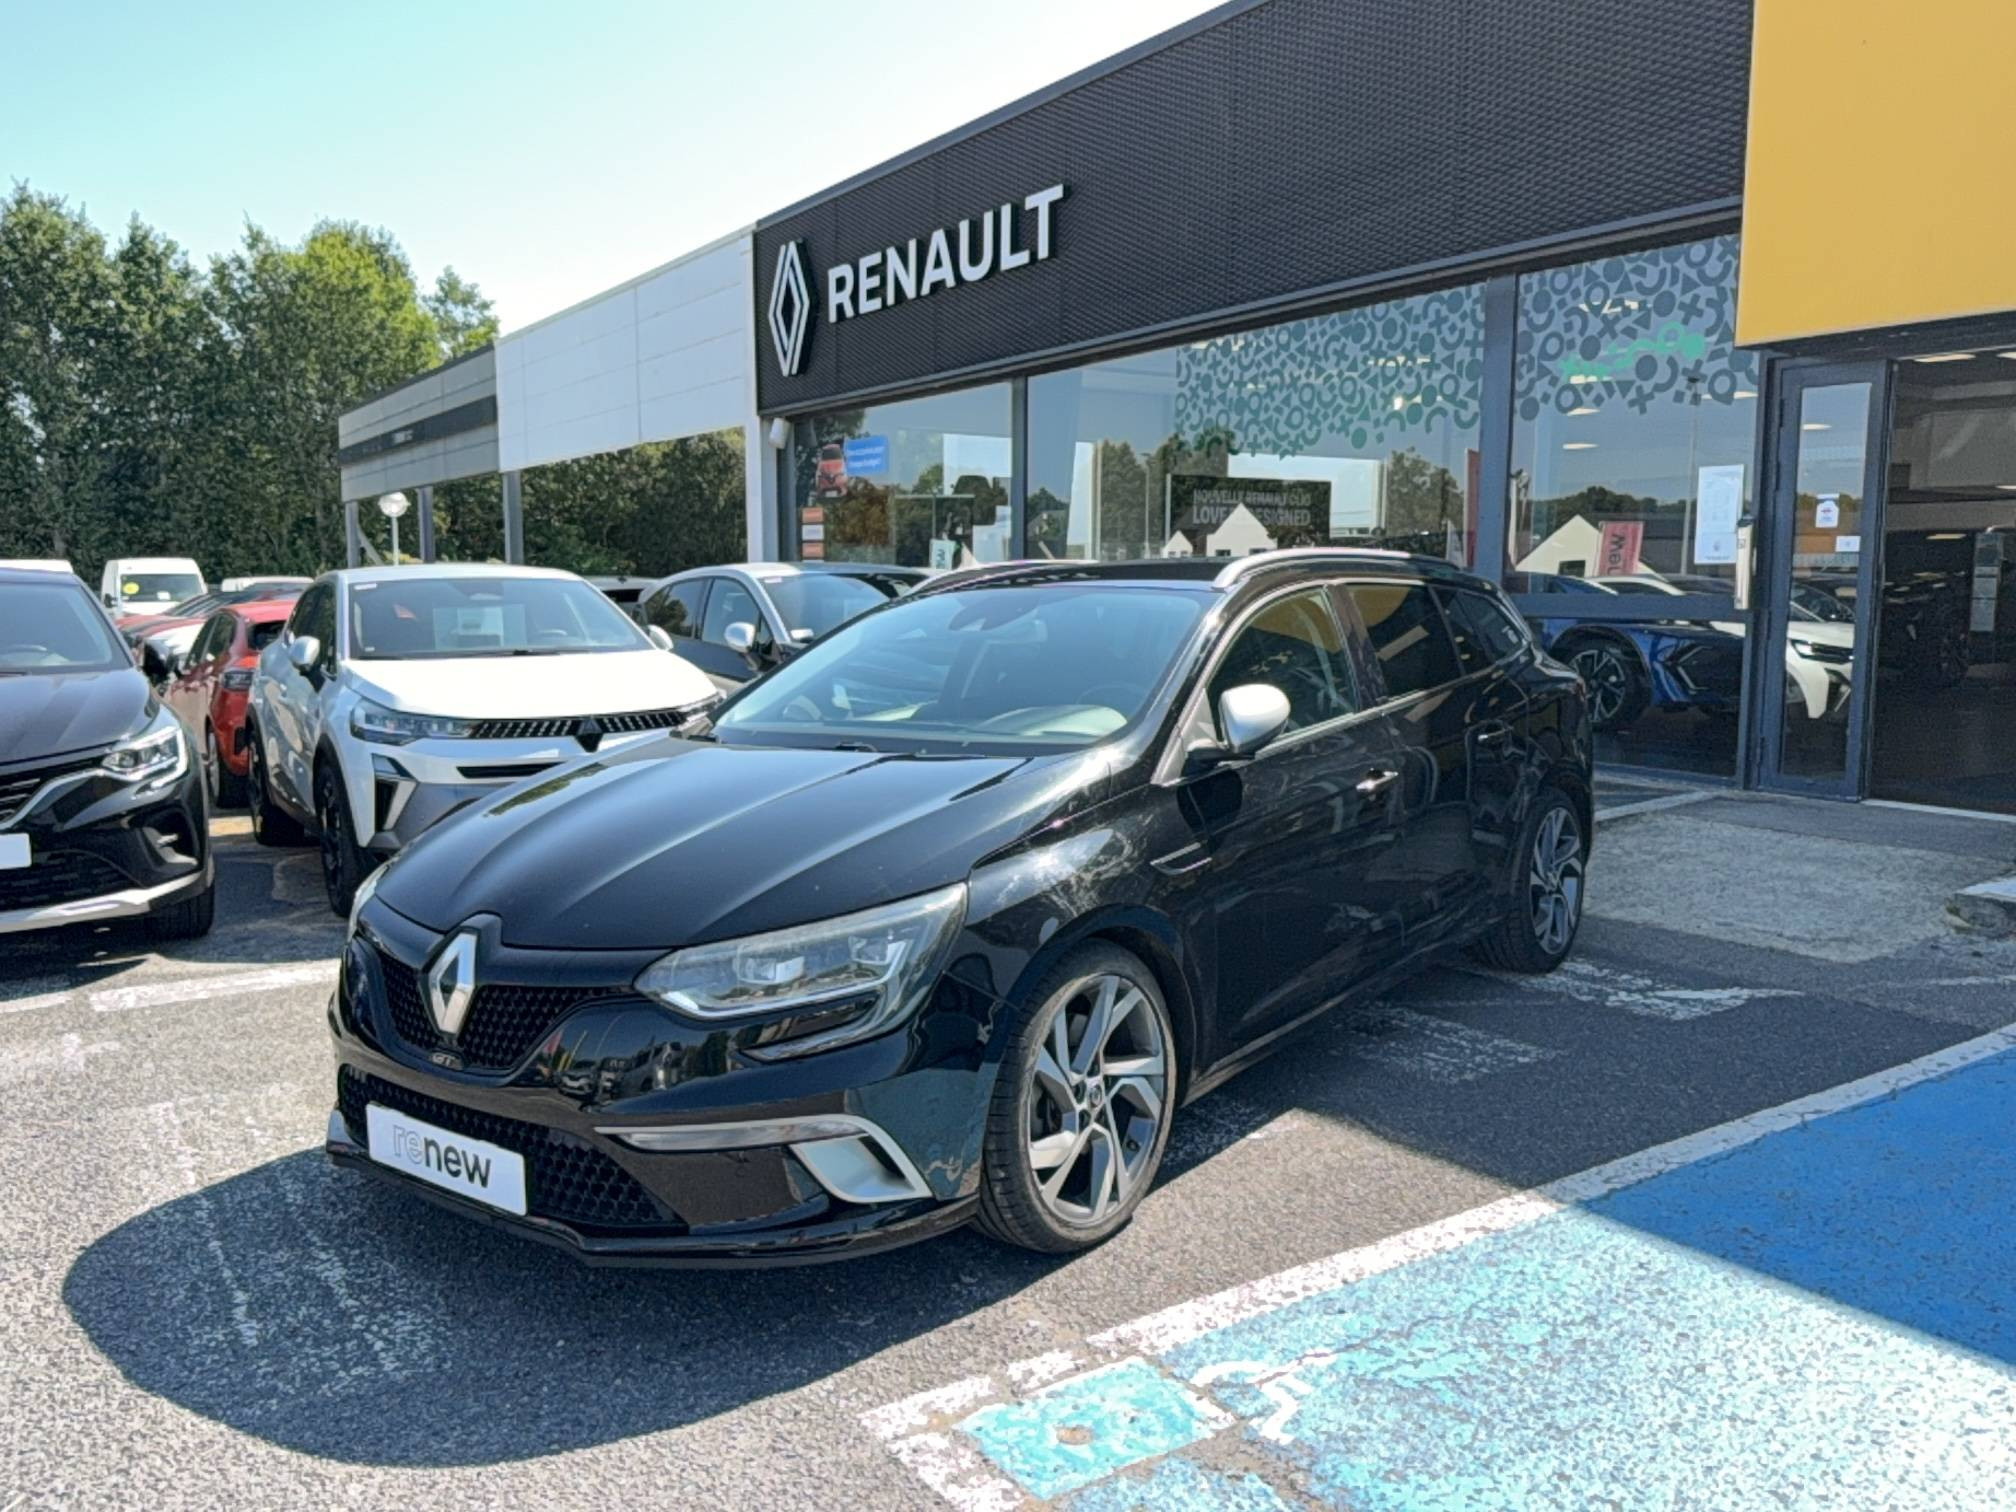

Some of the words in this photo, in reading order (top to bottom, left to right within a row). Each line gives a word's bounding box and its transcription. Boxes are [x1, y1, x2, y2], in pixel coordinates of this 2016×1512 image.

[828, 184, 1064, 323] RENAULT
[432, 1052, 456, 1067] GT
[392, 1124, 492, 1188] renew
